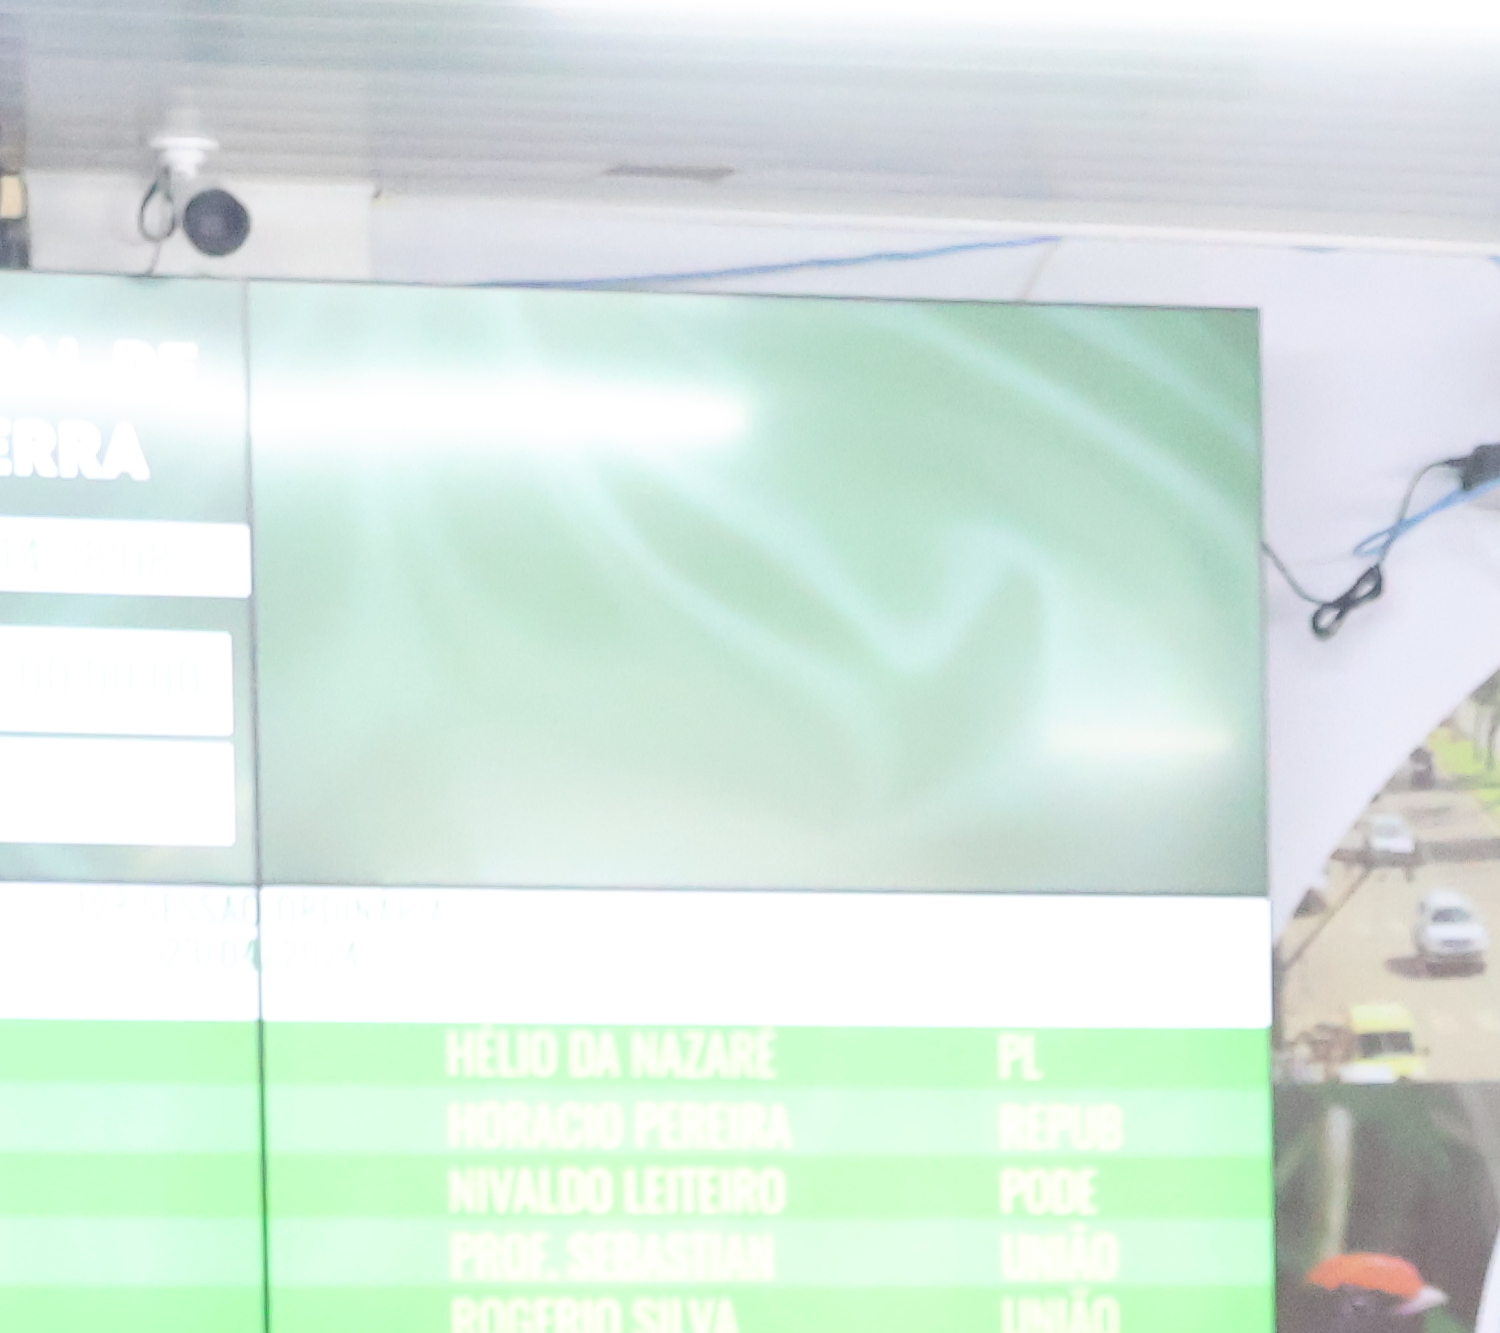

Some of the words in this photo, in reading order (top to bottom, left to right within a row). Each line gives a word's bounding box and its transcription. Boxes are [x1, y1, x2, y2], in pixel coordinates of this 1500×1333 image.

[568, 1028, 623, 1080] DA
[997, 1029, 1045, 1082] PL
[633, 1102, 795, 1152] PEREIRA
[999, 1101, 1126, 1153] REPUB
[447, 1164, 617, 1217] NIVALDO
[622, 1165, 788, 1217] LEITEIRO
[1001, 1164, 1100, 1218] PODE
[449, 1231, 560, 1283] PROF.
[1001, 1221, 1122, 1283] UNIÃO
